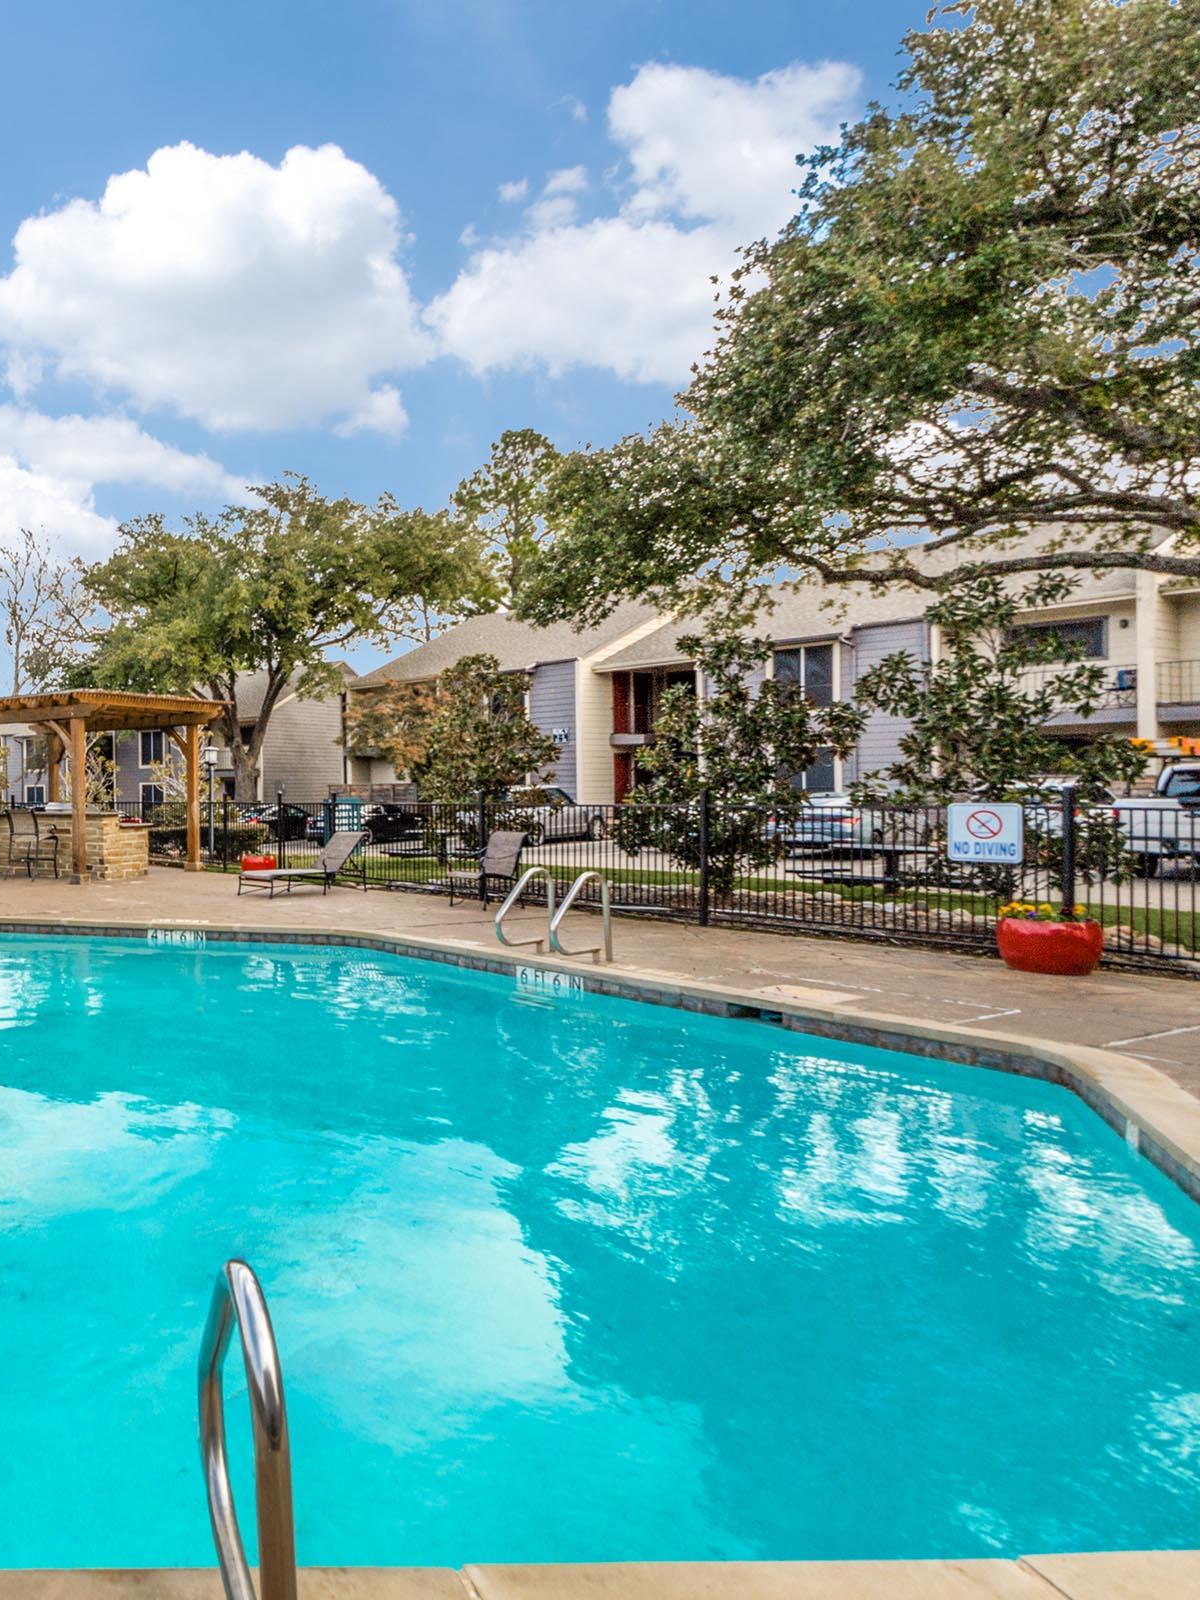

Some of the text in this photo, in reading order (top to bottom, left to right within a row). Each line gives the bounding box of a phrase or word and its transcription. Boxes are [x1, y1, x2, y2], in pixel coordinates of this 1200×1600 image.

[953, 841, 1016, 857] NO DIVING
[180, 930, 187, 943] 6
[520, 967, 581, 990] 6 FT 6 IN
